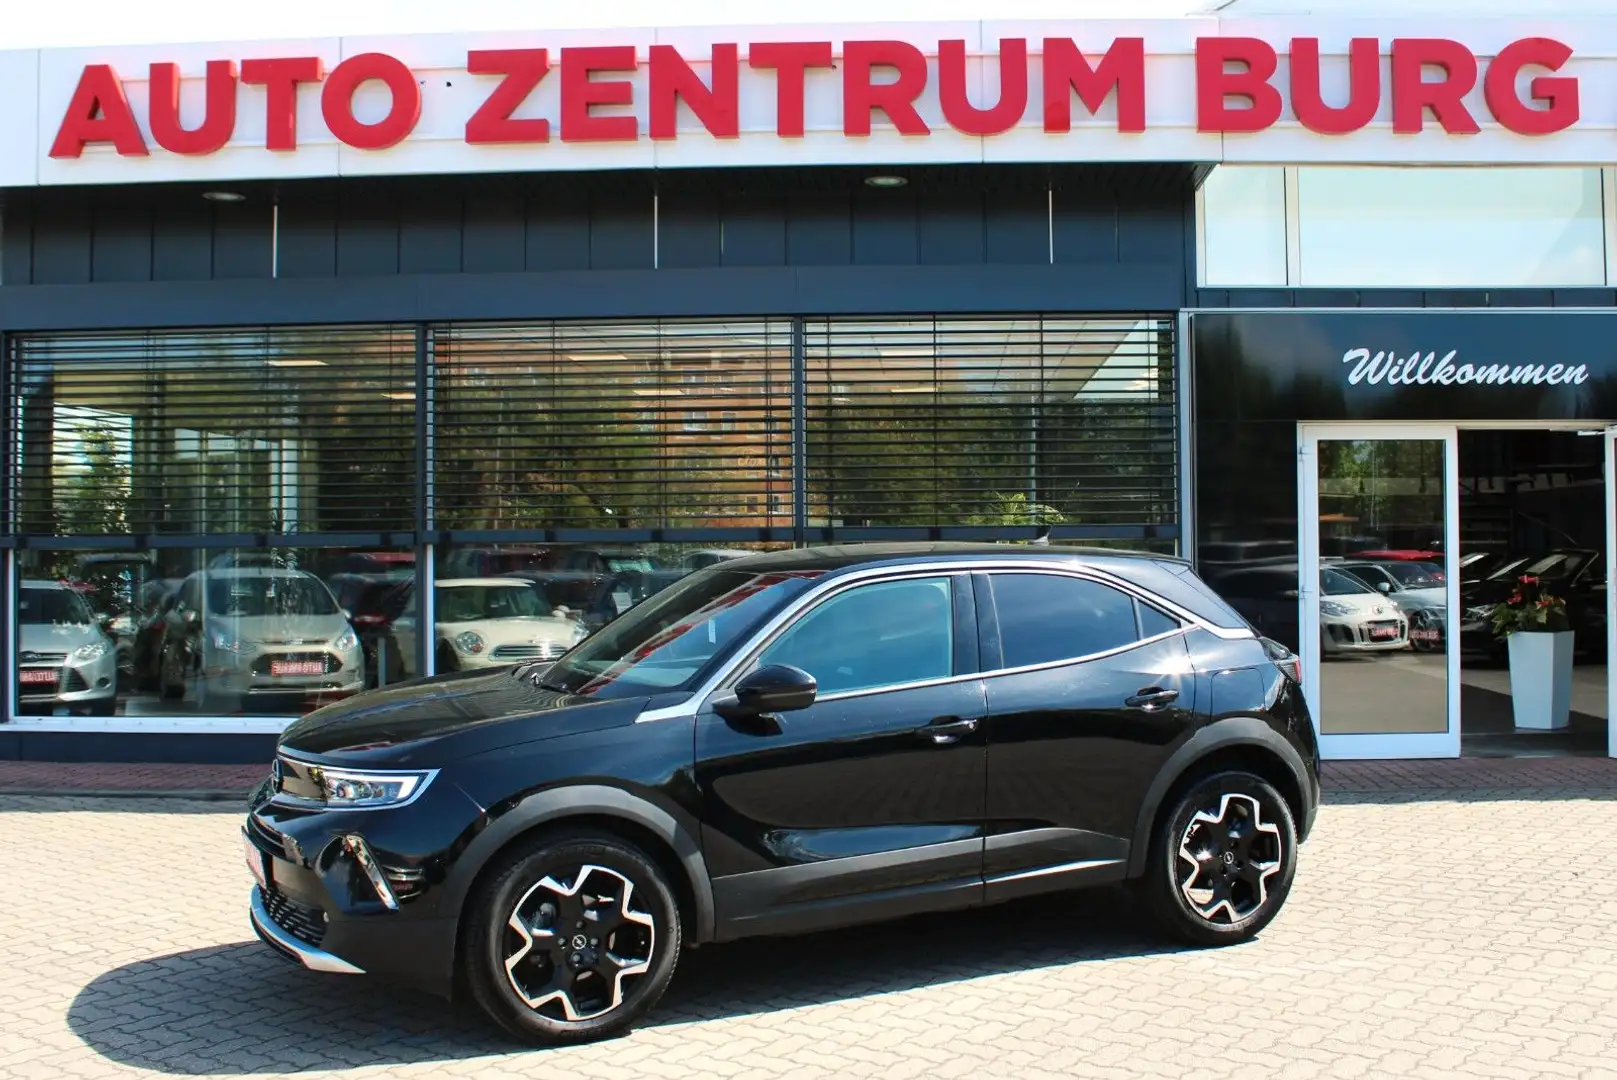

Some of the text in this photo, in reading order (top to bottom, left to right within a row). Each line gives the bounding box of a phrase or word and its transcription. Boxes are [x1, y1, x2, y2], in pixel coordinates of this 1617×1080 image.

[51, 37, 1580, 158] AUTO ZENTRUM BURG
[1343, 348, 1589, 386] Willkommen
